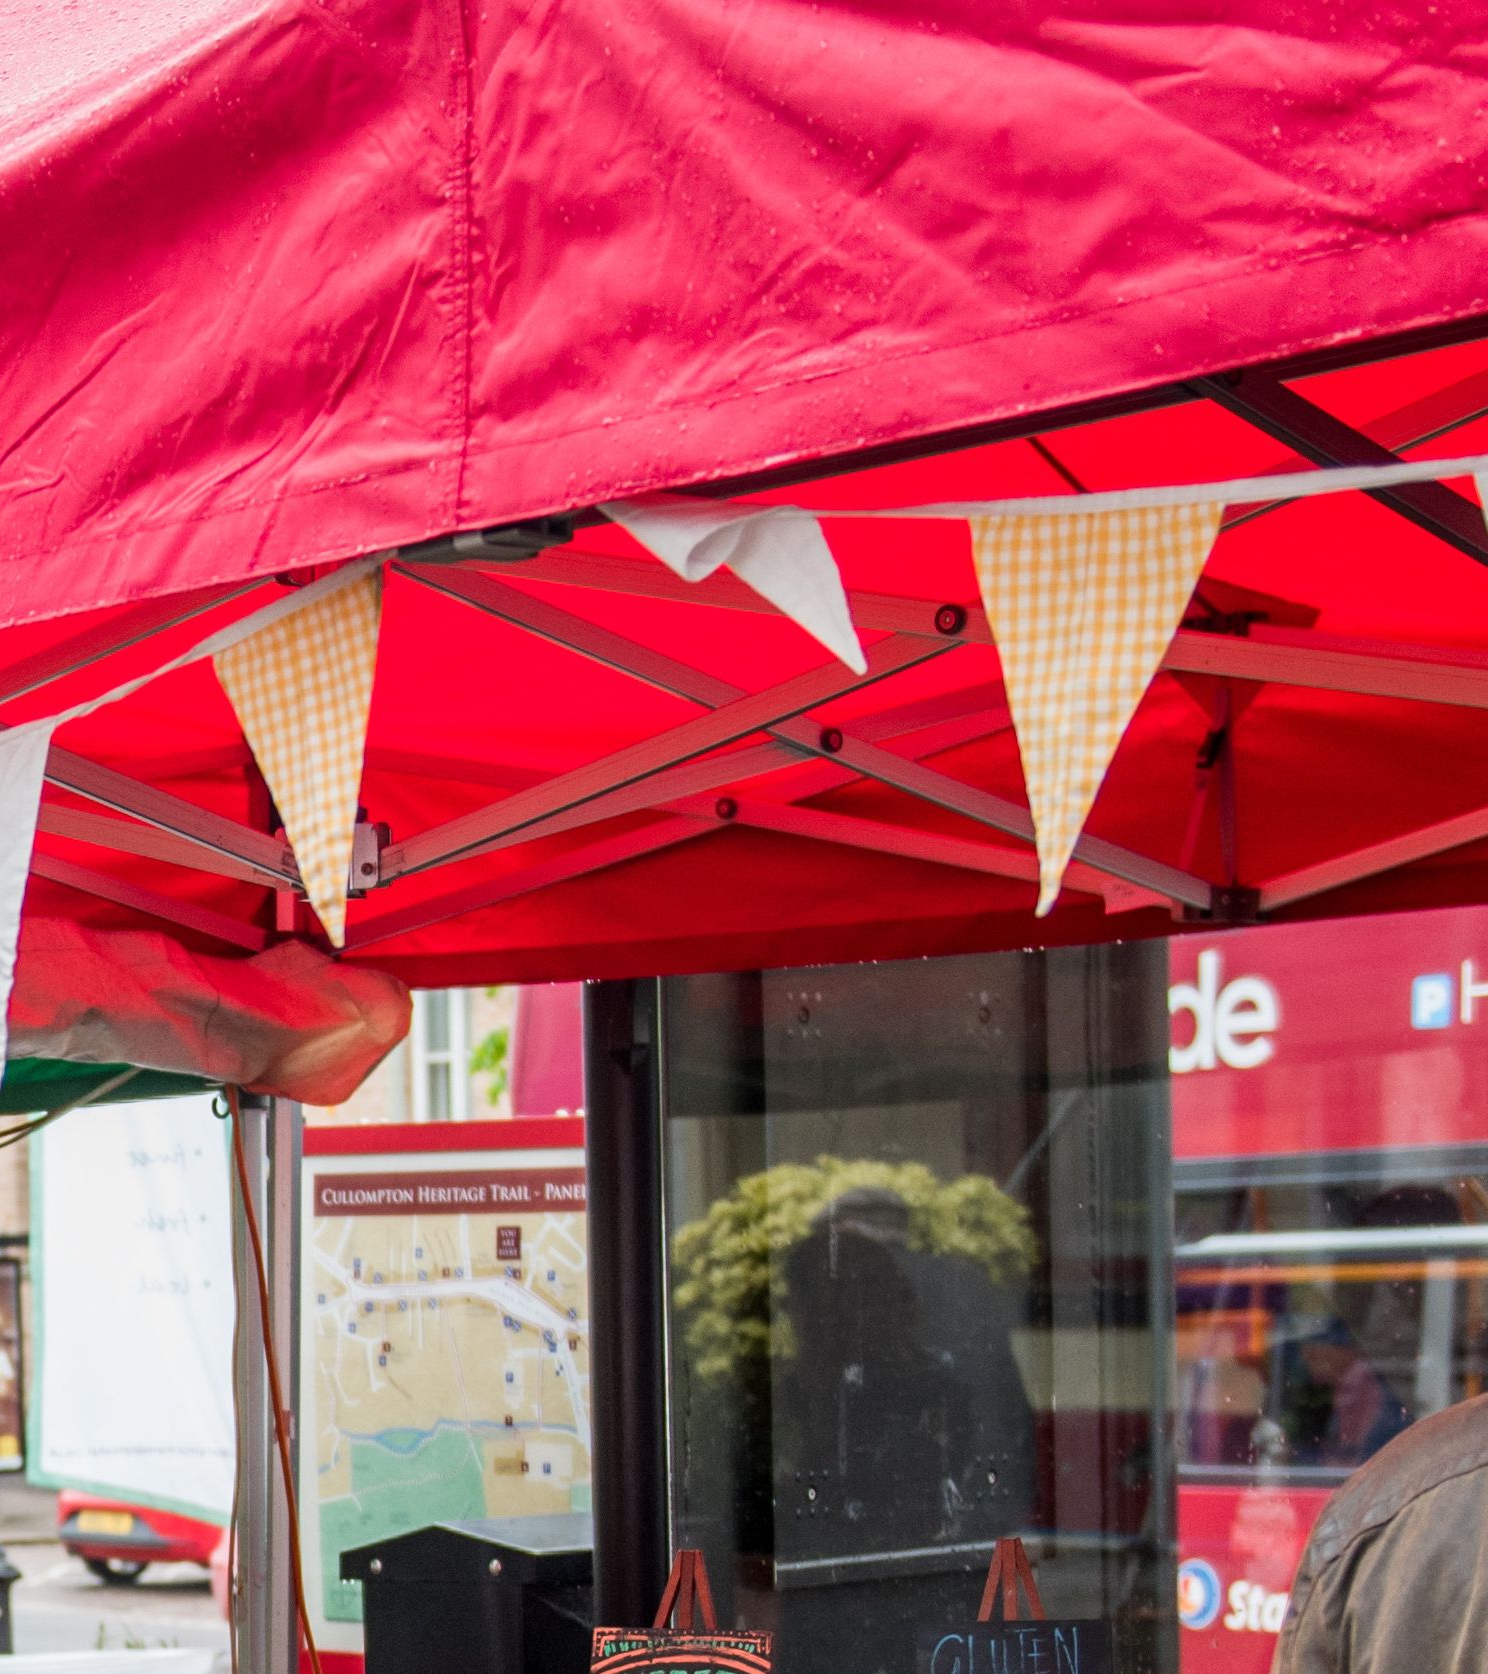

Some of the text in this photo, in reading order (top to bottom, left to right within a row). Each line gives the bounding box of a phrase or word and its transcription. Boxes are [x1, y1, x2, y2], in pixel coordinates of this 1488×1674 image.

[321, 1187, 413, 1205] CULLOMPTON
[418, 1185, 487, 1202] HERITAGE
[490, 1183, 530, 1200] TRAIL
